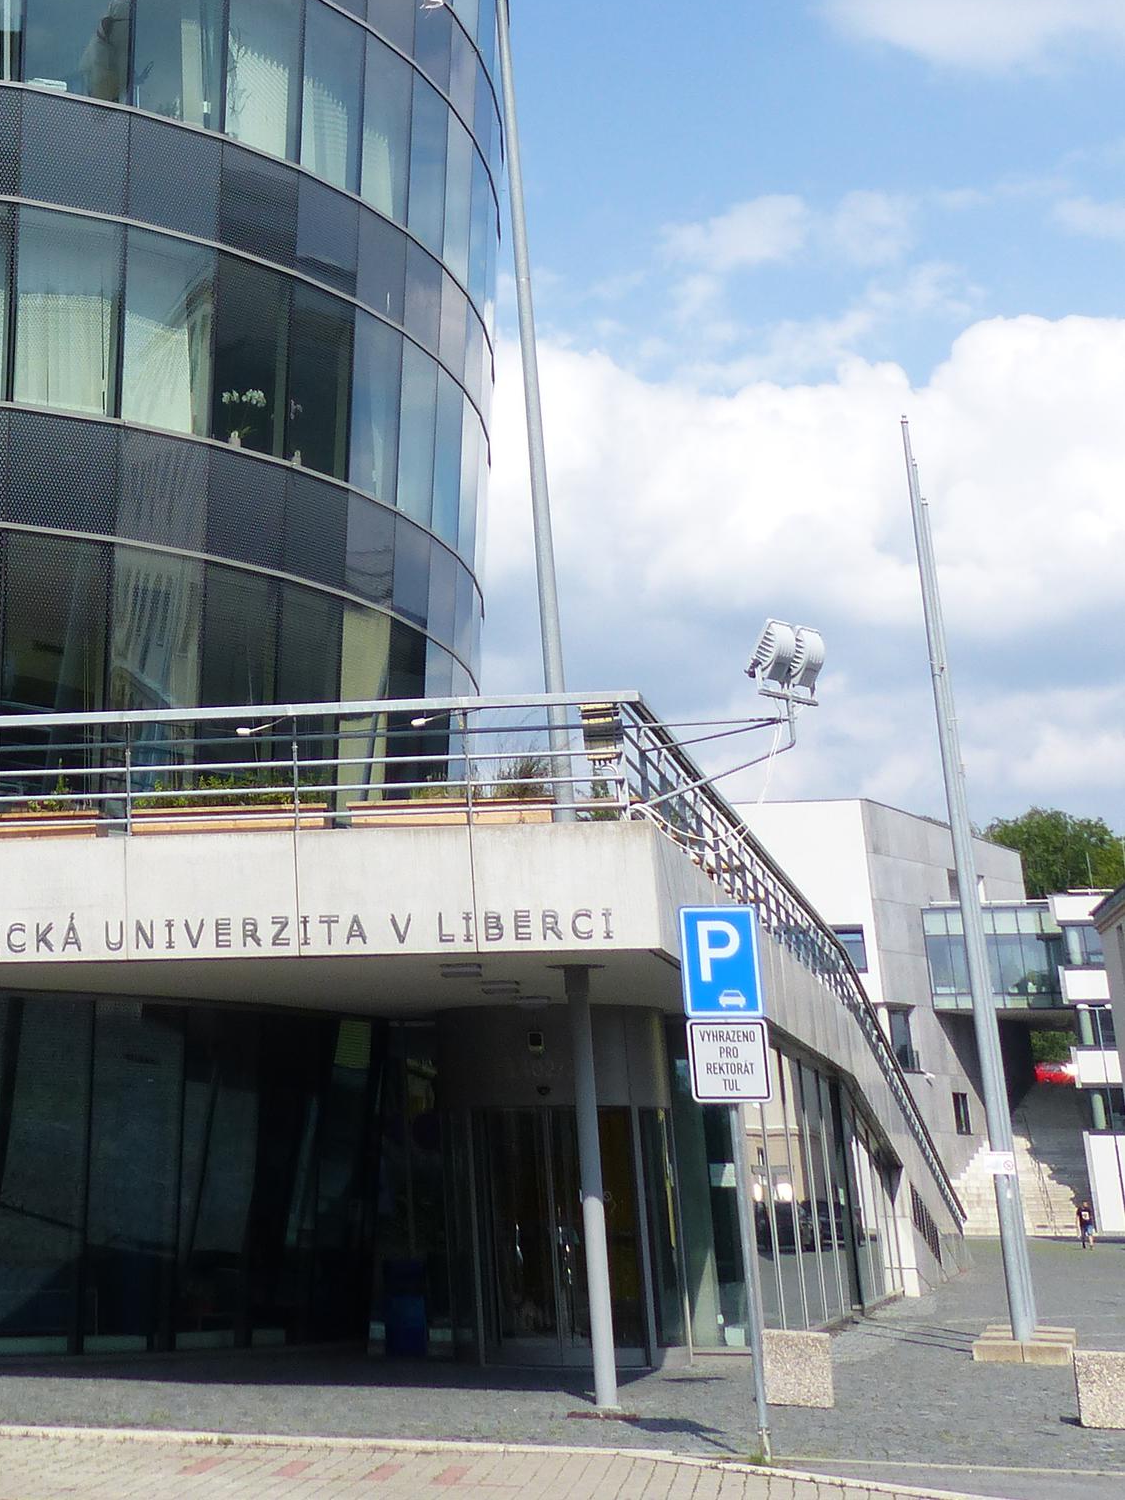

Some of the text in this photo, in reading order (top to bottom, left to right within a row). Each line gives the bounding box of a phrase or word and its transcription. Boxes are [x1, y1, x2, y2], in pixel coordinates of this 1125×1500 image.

[105, 913, 368, 952] UNIVERZITA
[389, 912, 412, 946] V
[437, 908, 616, 945] LIBERCI
[696, 920, 740, 982] P
[698, 1029, 756, 1043] VYHRAZENO
[718, 1046, 739, 1059] PRO
[705, 1060, 755, 1075] REKTORÁT
[722, 1078, 741, 1092] TUL
